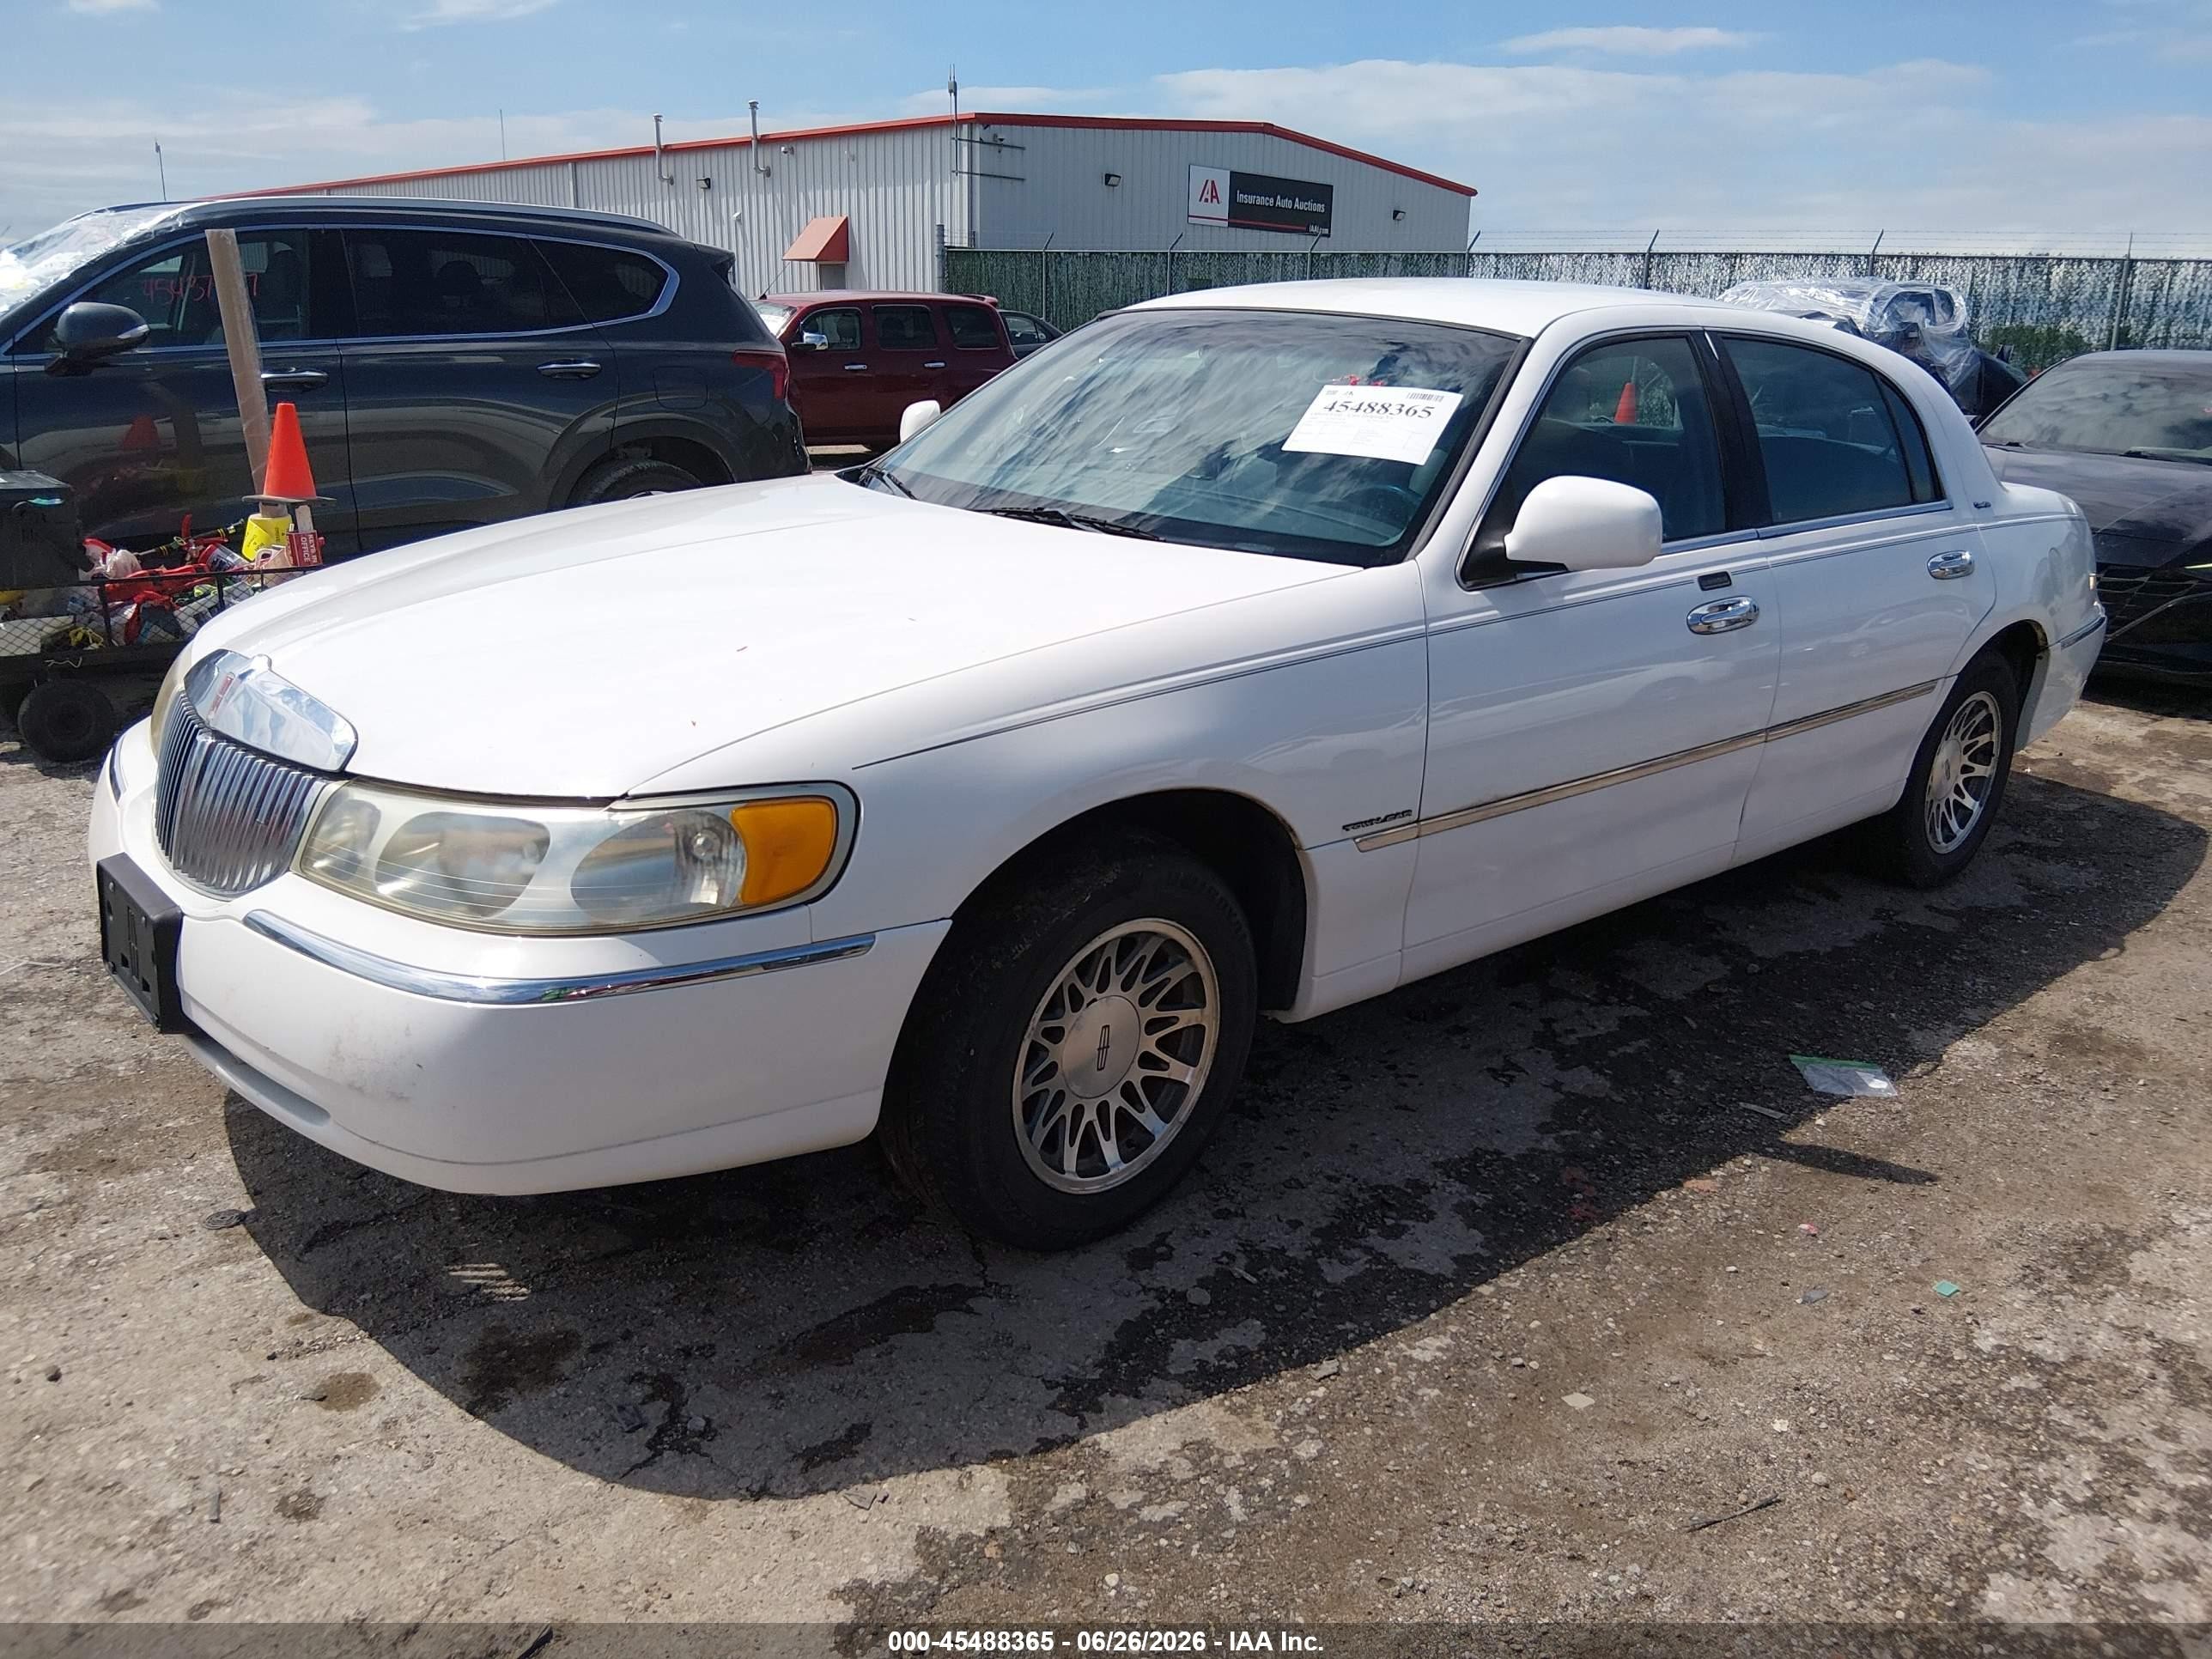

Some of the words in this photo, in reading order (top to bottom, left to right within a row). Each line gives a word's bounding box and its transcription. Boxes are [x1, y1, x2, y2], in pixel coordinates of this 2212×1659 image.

[1237, 190, 1274, 207] Insurance
[1275, 194, 1292, 210] Auto
[1293, 197, 1325, 213] Auctions
[1323, 400, 1436, 419] 45488365
[301, 537, 311, 562] OFFICE
